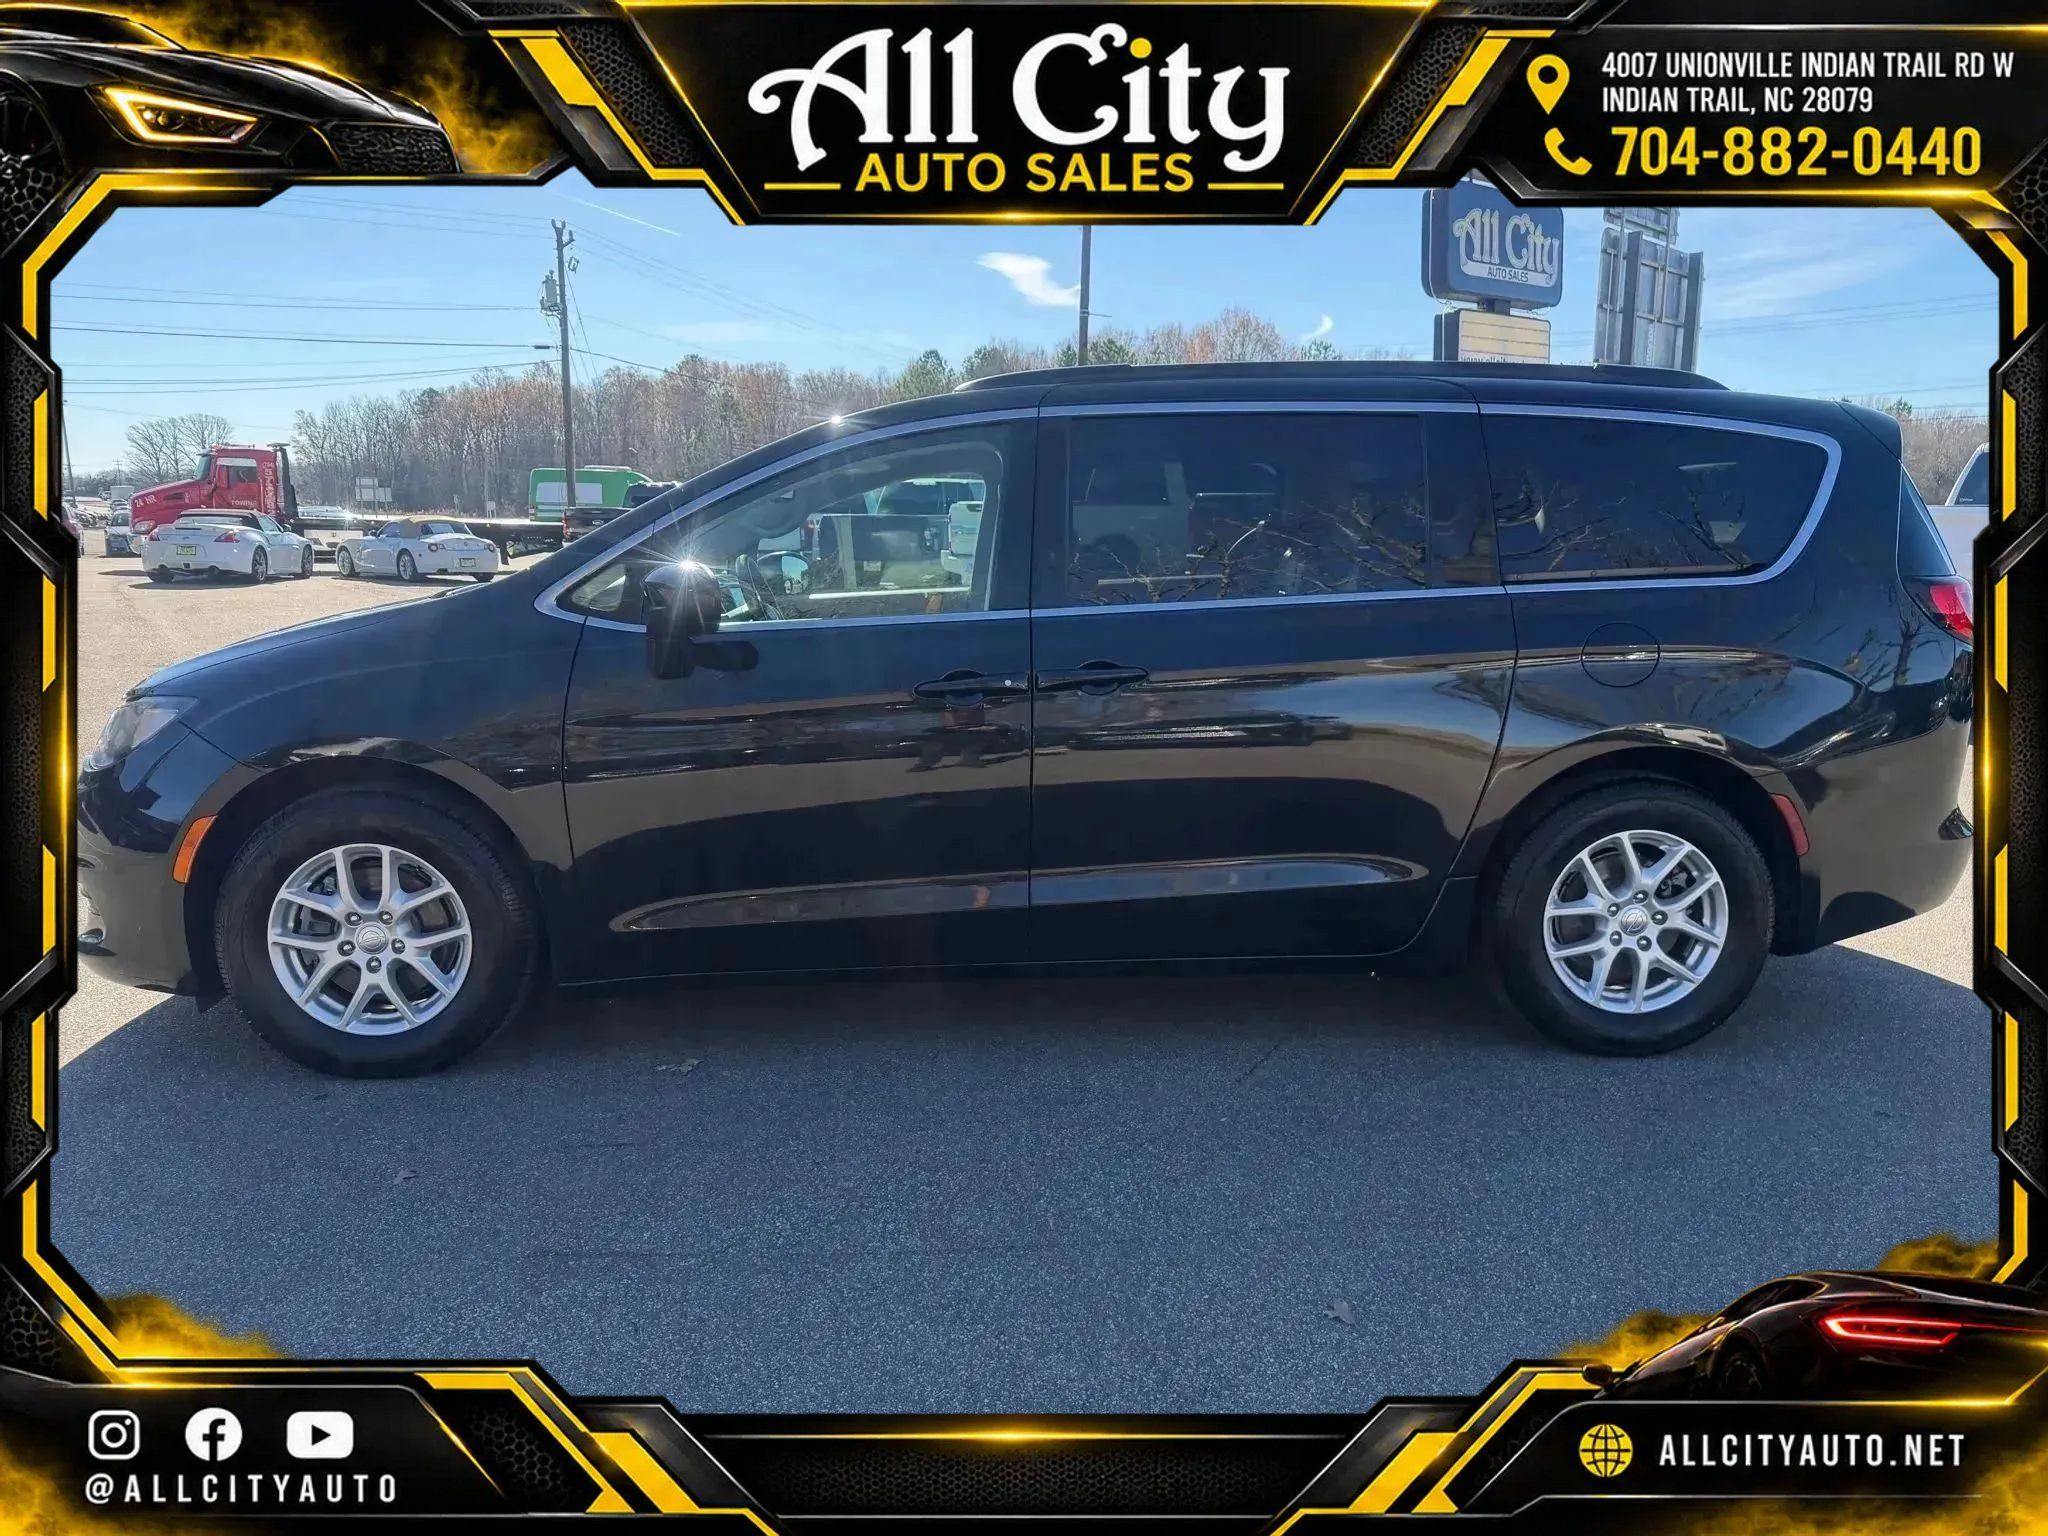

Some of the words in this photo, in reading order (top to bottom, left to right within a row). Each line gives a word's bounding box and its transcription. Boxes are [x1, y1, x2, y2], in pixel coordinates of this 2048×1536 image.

[1453, 208, 1499, 268] All
[1505, 213, 1560, 286] City
[1487, 266, 1507, 280] AUTO
[1508, 269, 1529, 283] SALES
[134, 498, 144, 508] 24
[144, 494, 157, 505] HR
